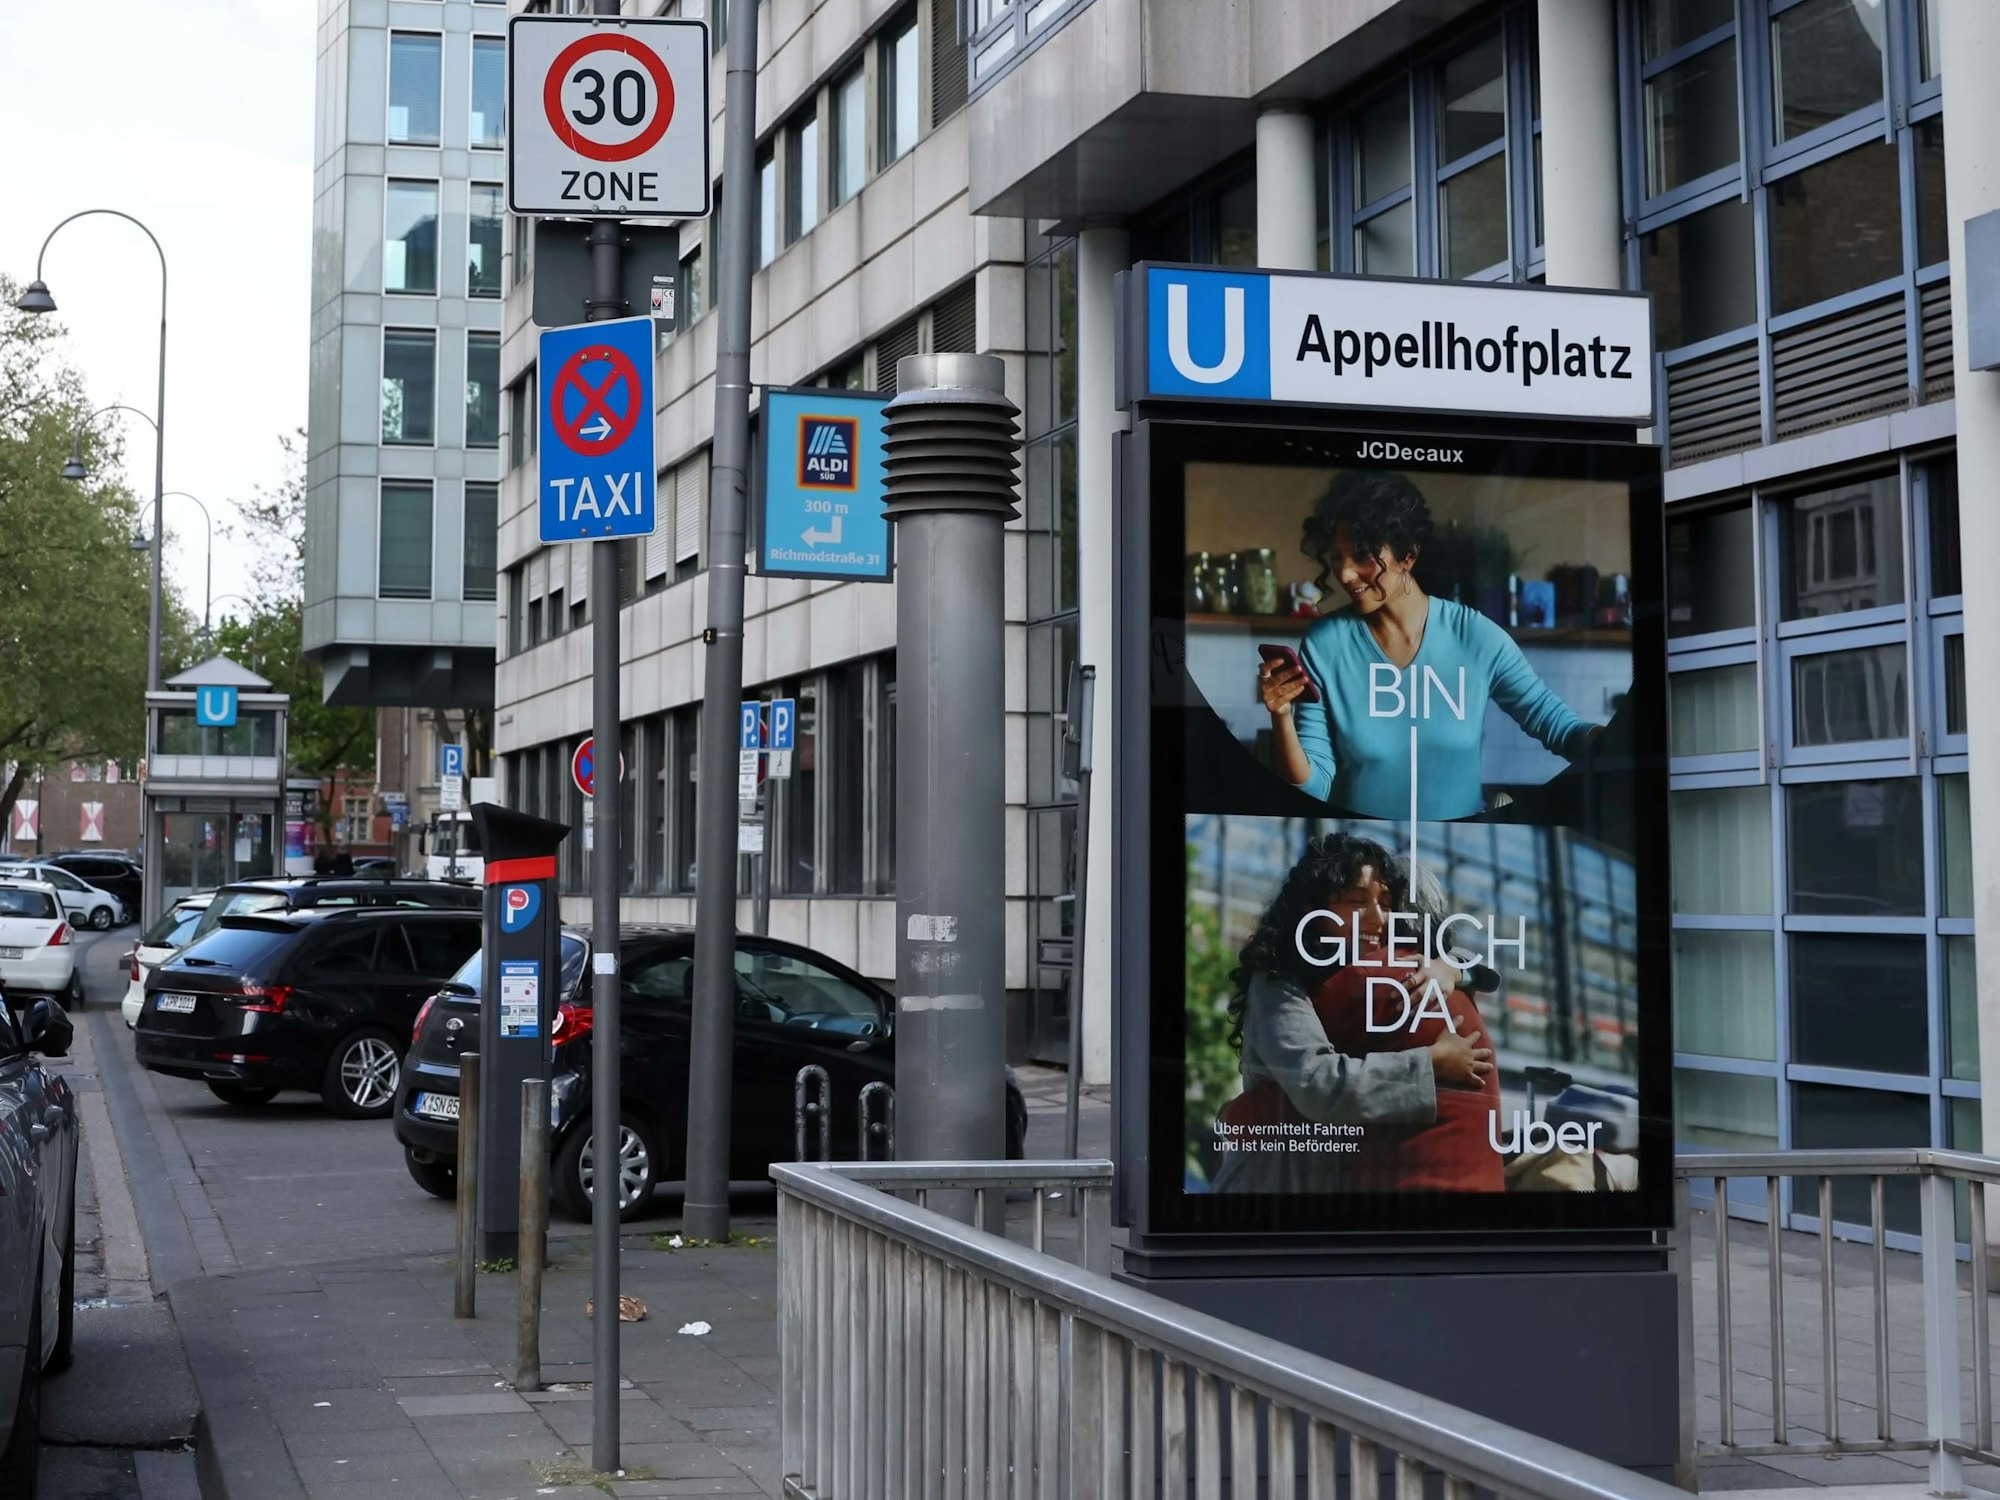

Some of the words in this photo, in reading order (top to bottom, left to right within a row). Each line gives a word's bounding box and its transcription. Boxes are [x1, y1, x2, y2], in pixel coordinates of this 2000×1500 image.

[571, 68, 647, 126] 30
[561, 170, 659, 202] ZONE
[1168, 283, 1246, 384] U
[1296, 313, 1633, 386] Appellhofplatz
[807, 457, 848, 472] ALDI
[1356, 441, 1464, 463] JCDecaux
[820, 471, 835, 480] SÜD
[550, 471, 643, 523] TAXI
[804, 500, 831, 513] 300
[835, 503, 848, 514] m
[771, 548, 865, 565] Richmodstraße
[866, 553, 880, 565] 31
[205, 690, 229, 722] U
[1368, 663, 1466, 721] BIN
[743, 709, 755, 748] P
[775, 707, 789, 747] P
[1295, 909, 1526, 970] GLEICH
[1365, 976, 1458, 1034] DA
[447, 1099, 460, 1115] 85
[1213, 1121, 1244, 1135] Uber
[1248, 1122, 1311, 1136] vermittelt
[1314, 1123, 1364, 1136] Fahrten
[1213, 1139, 1238, 1152] und
[1242, 1139, 1256, 1152] ist
[1260, 1139, 1285, 1152] kein
[1289, 1139, 1360, 1153] Beförderer.
[1488, 1109, 1602, 1155] Uber
